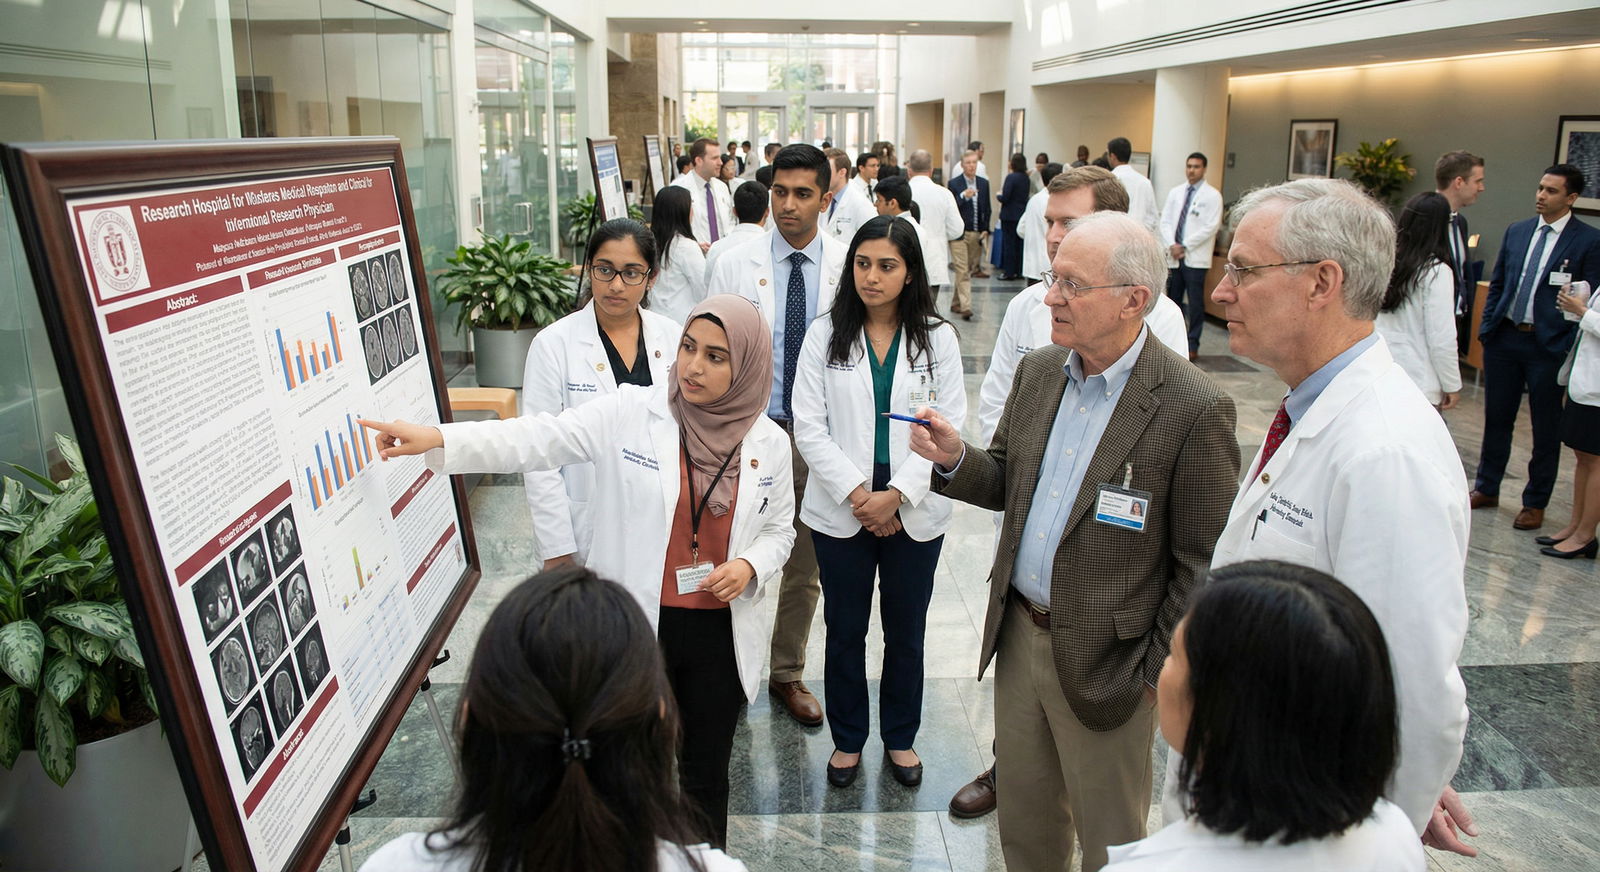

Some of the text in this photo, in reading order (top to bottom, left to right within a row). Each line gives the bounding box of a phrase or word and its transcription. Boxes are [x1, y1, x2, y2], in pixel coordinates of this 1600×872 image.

[140, 200, 192, 223] Research
[192, 194, 232, 216] Hospital
[231, 193, 245, 208] for
[280, 184, 306, 201] Medical
[337, 179, 349, 192] and
[269, 205, 304, 224] Research
[302, 200, 335, 219] Physician
